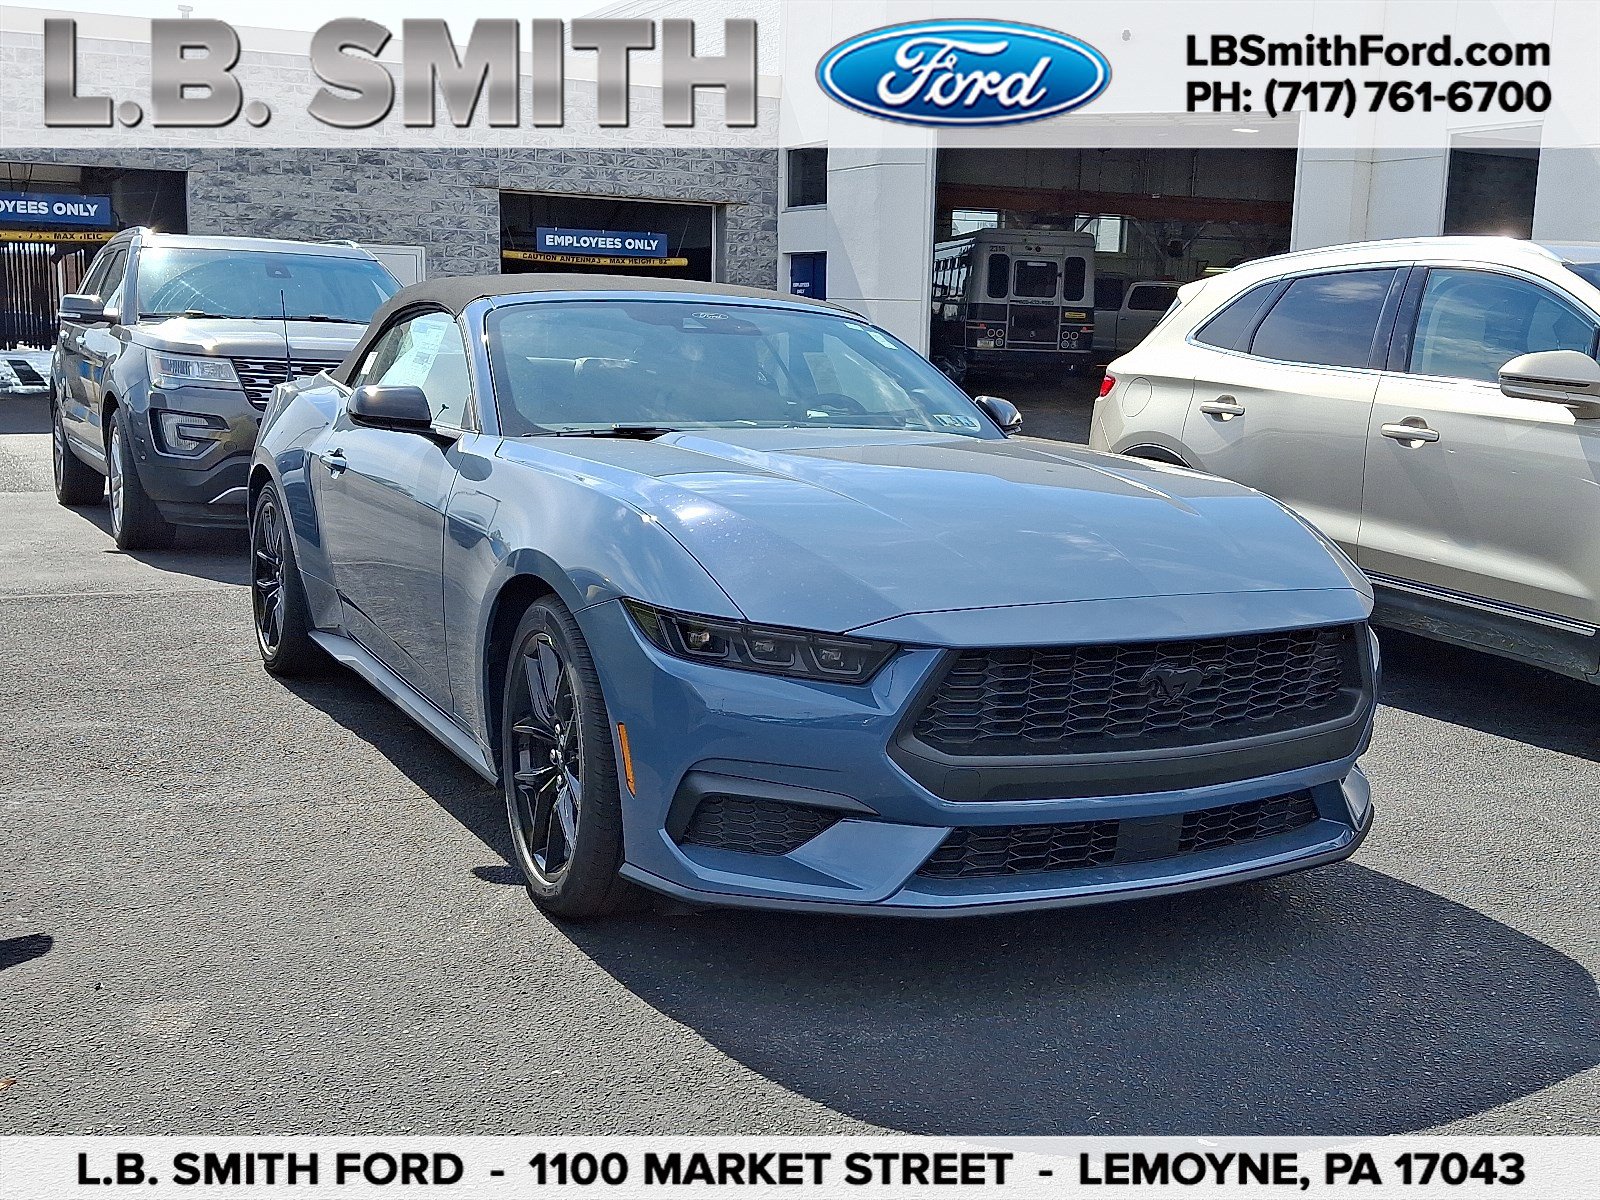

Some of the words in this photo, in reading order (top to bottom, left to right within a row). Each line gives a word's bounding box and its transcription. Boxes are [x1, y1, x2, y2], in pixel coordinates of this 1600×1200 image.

[53, 202, 98, 217] ONLY
[545, 234, 622, 249] EMPLOYEES
[625, 238, 659, 251] ONLY
[522, 252, 557, 262] CAUTION
